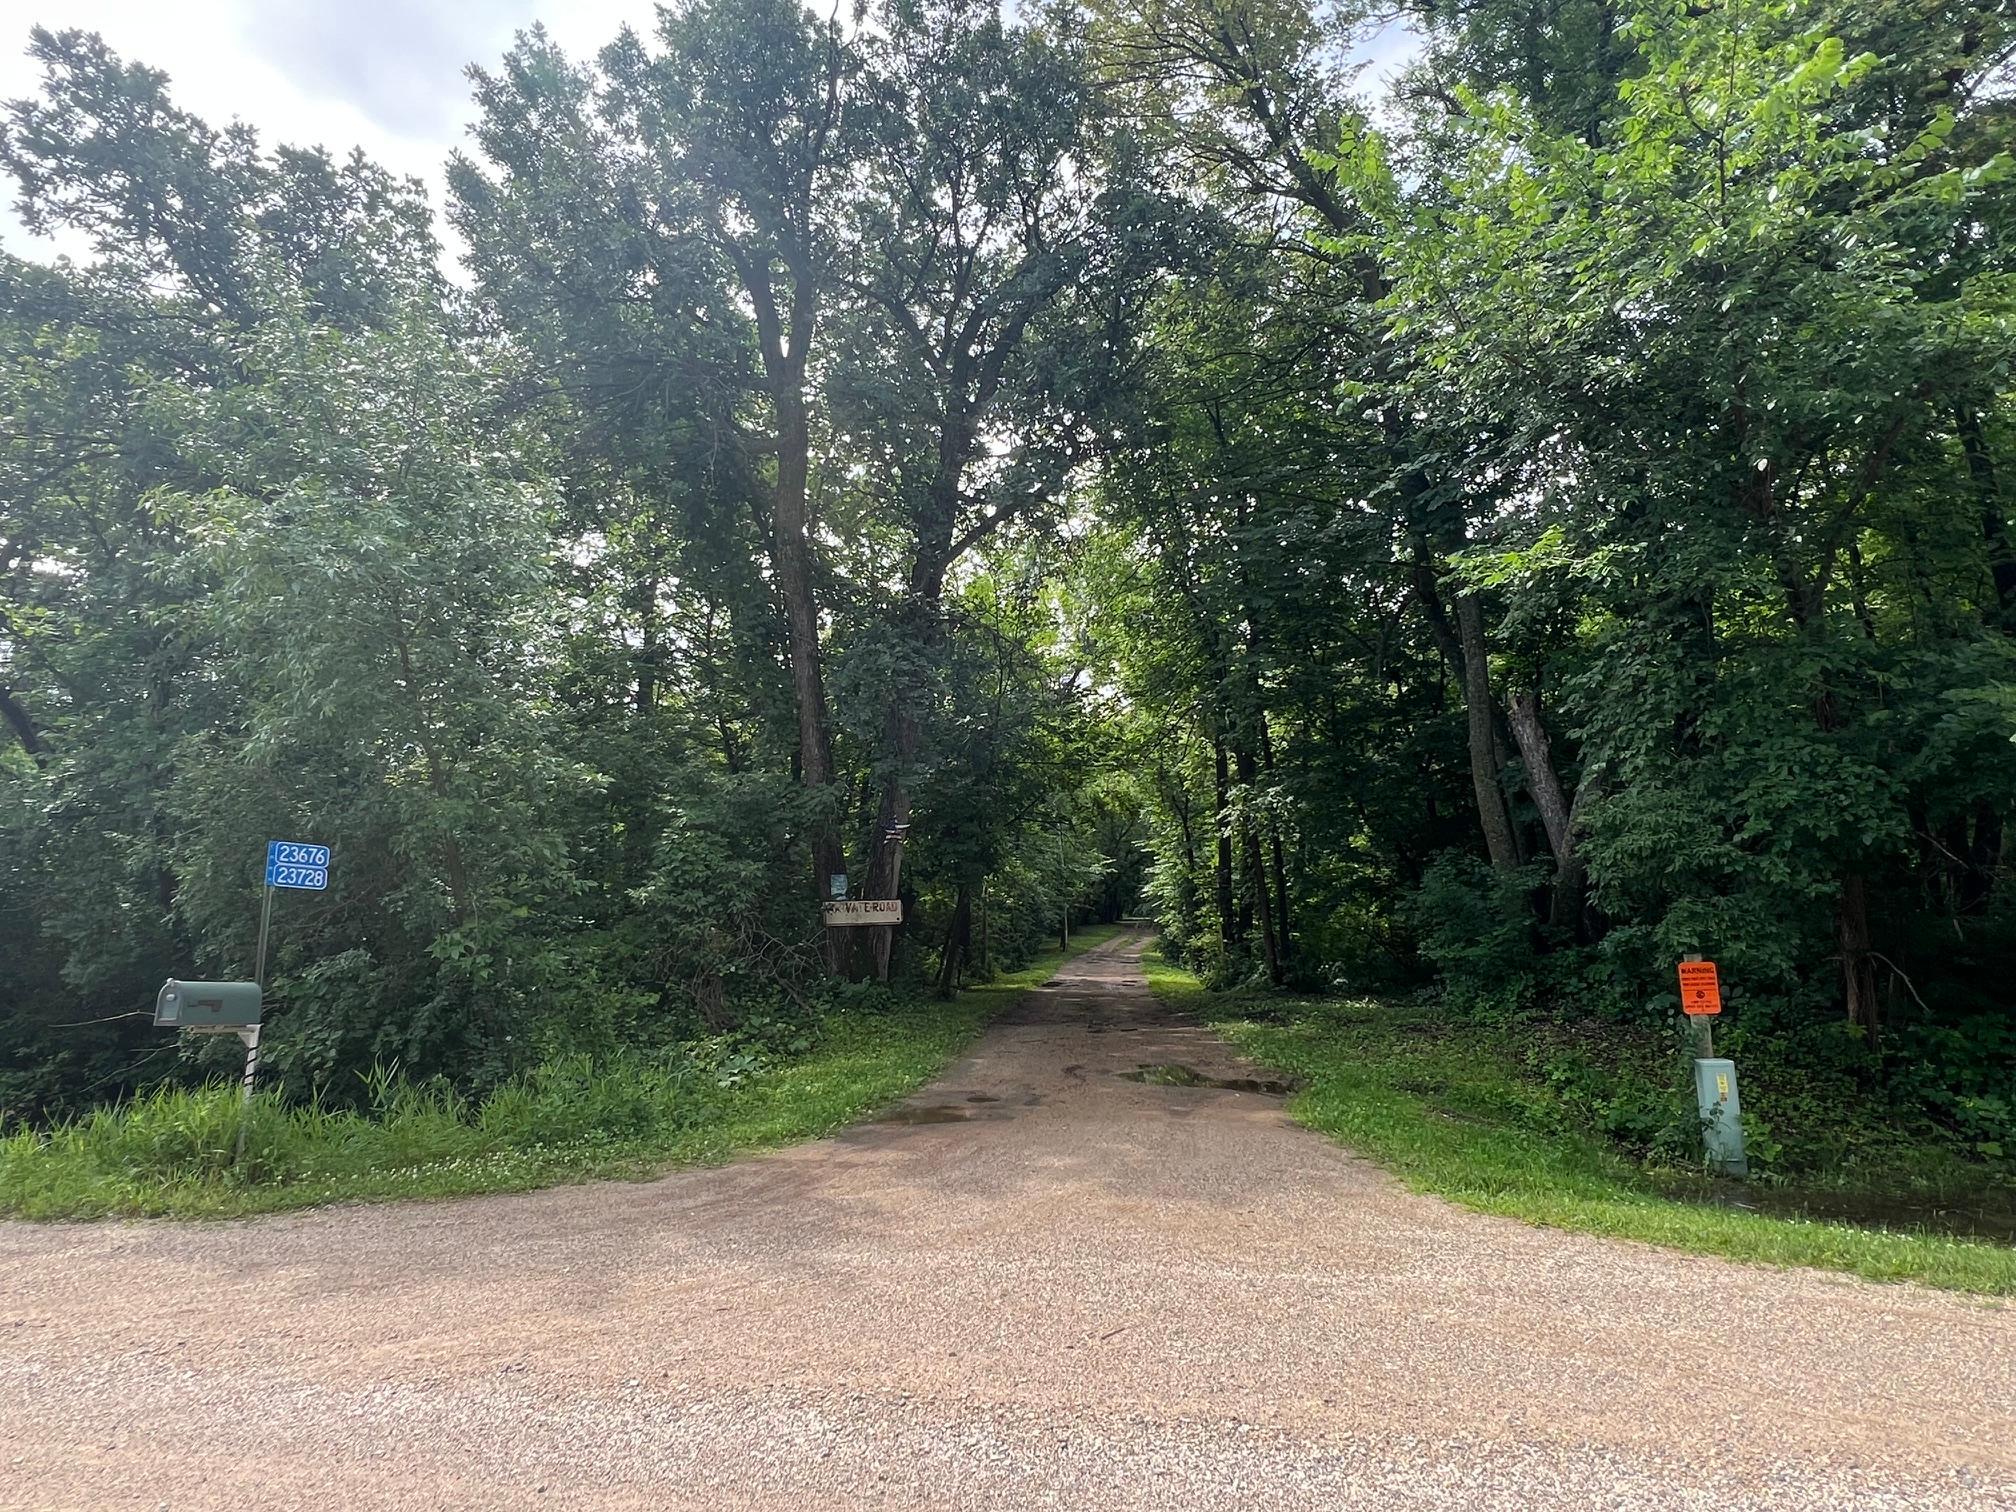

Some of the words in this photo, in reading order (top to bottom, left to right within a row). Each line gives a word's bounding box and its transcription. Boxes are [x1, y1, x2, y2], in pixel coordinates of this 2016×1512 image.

[279, 845, 325, 864] 23676
[277, 867, 324, 886] 23728
[872, 901, 898, 912] ROAD
[1681, 966, 1714, 974] WARNING
